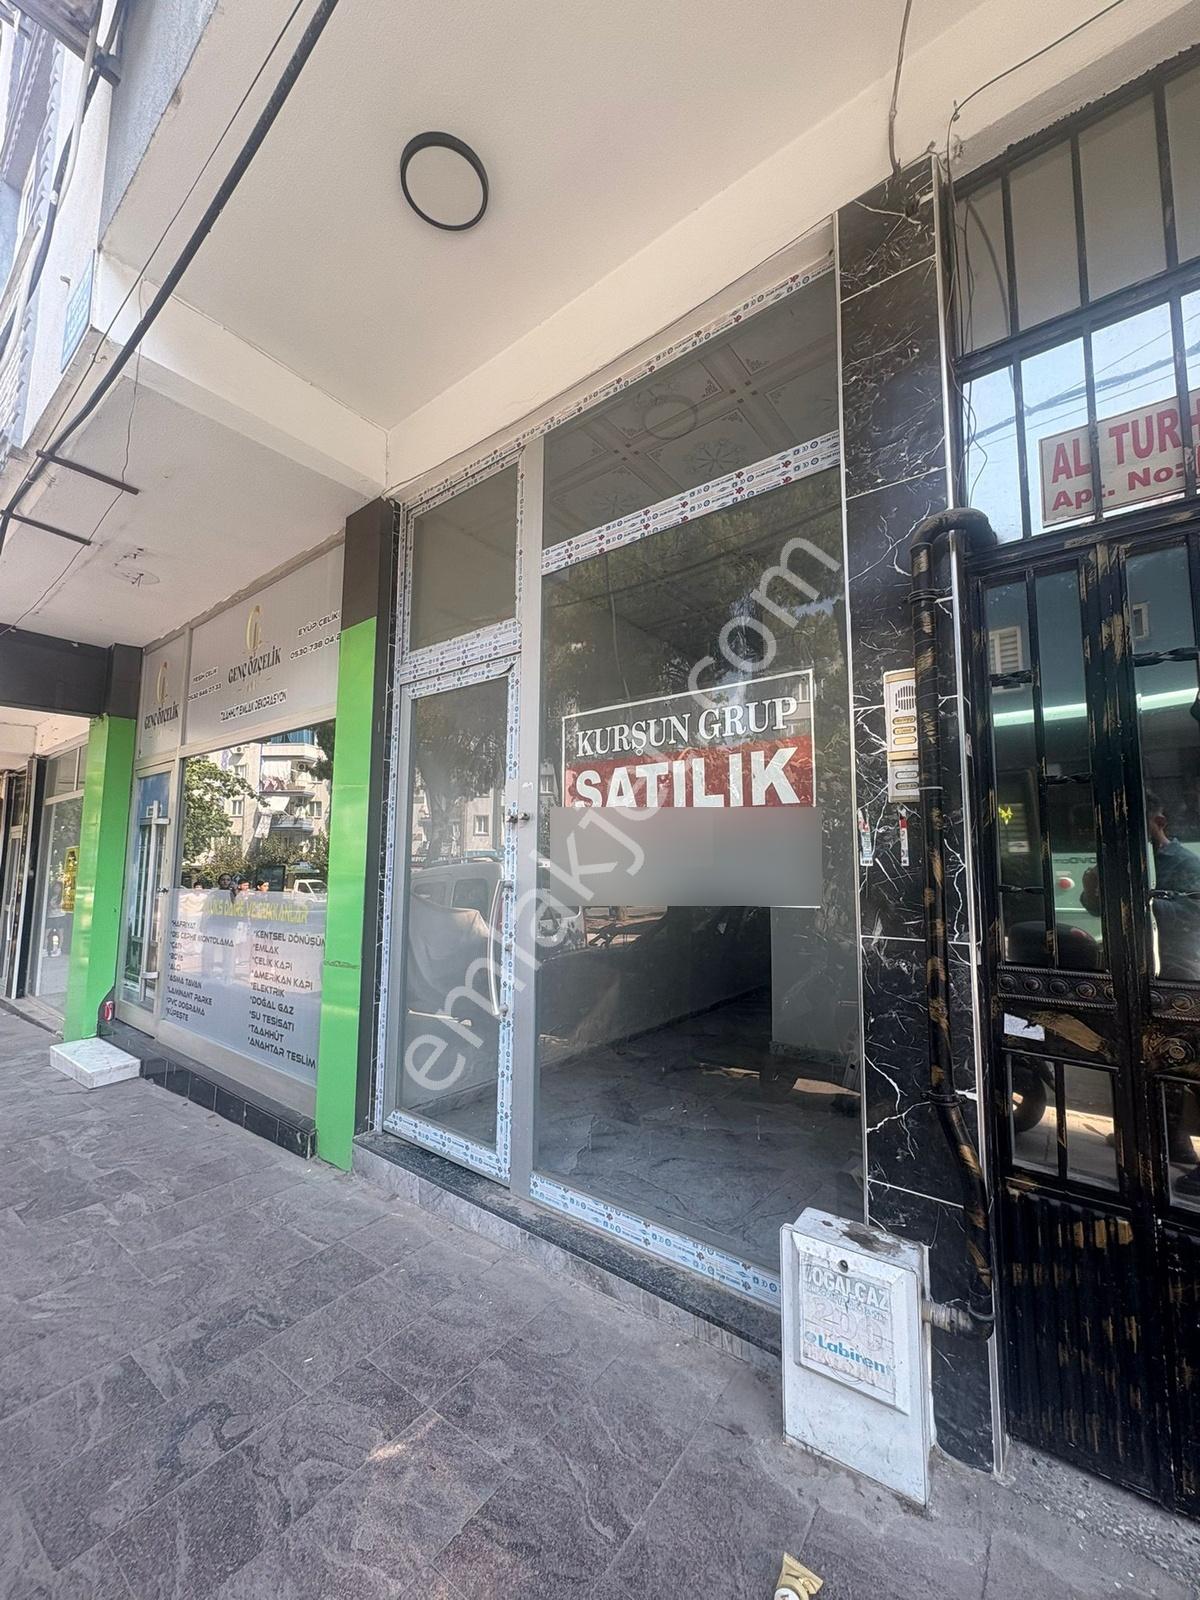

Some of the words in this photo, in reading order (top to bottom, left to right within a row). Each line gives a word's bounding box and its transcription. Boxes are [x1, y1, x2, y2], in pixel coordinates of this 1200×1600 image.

[1052, 485, 1116, 511] Ap.
[290, 647, 308, 659] 0530
[576, 713, 690, 757] KURŞUN
[700, 696, 798, 740] GRUP
[575, 747, 801, 808] SATILIK
